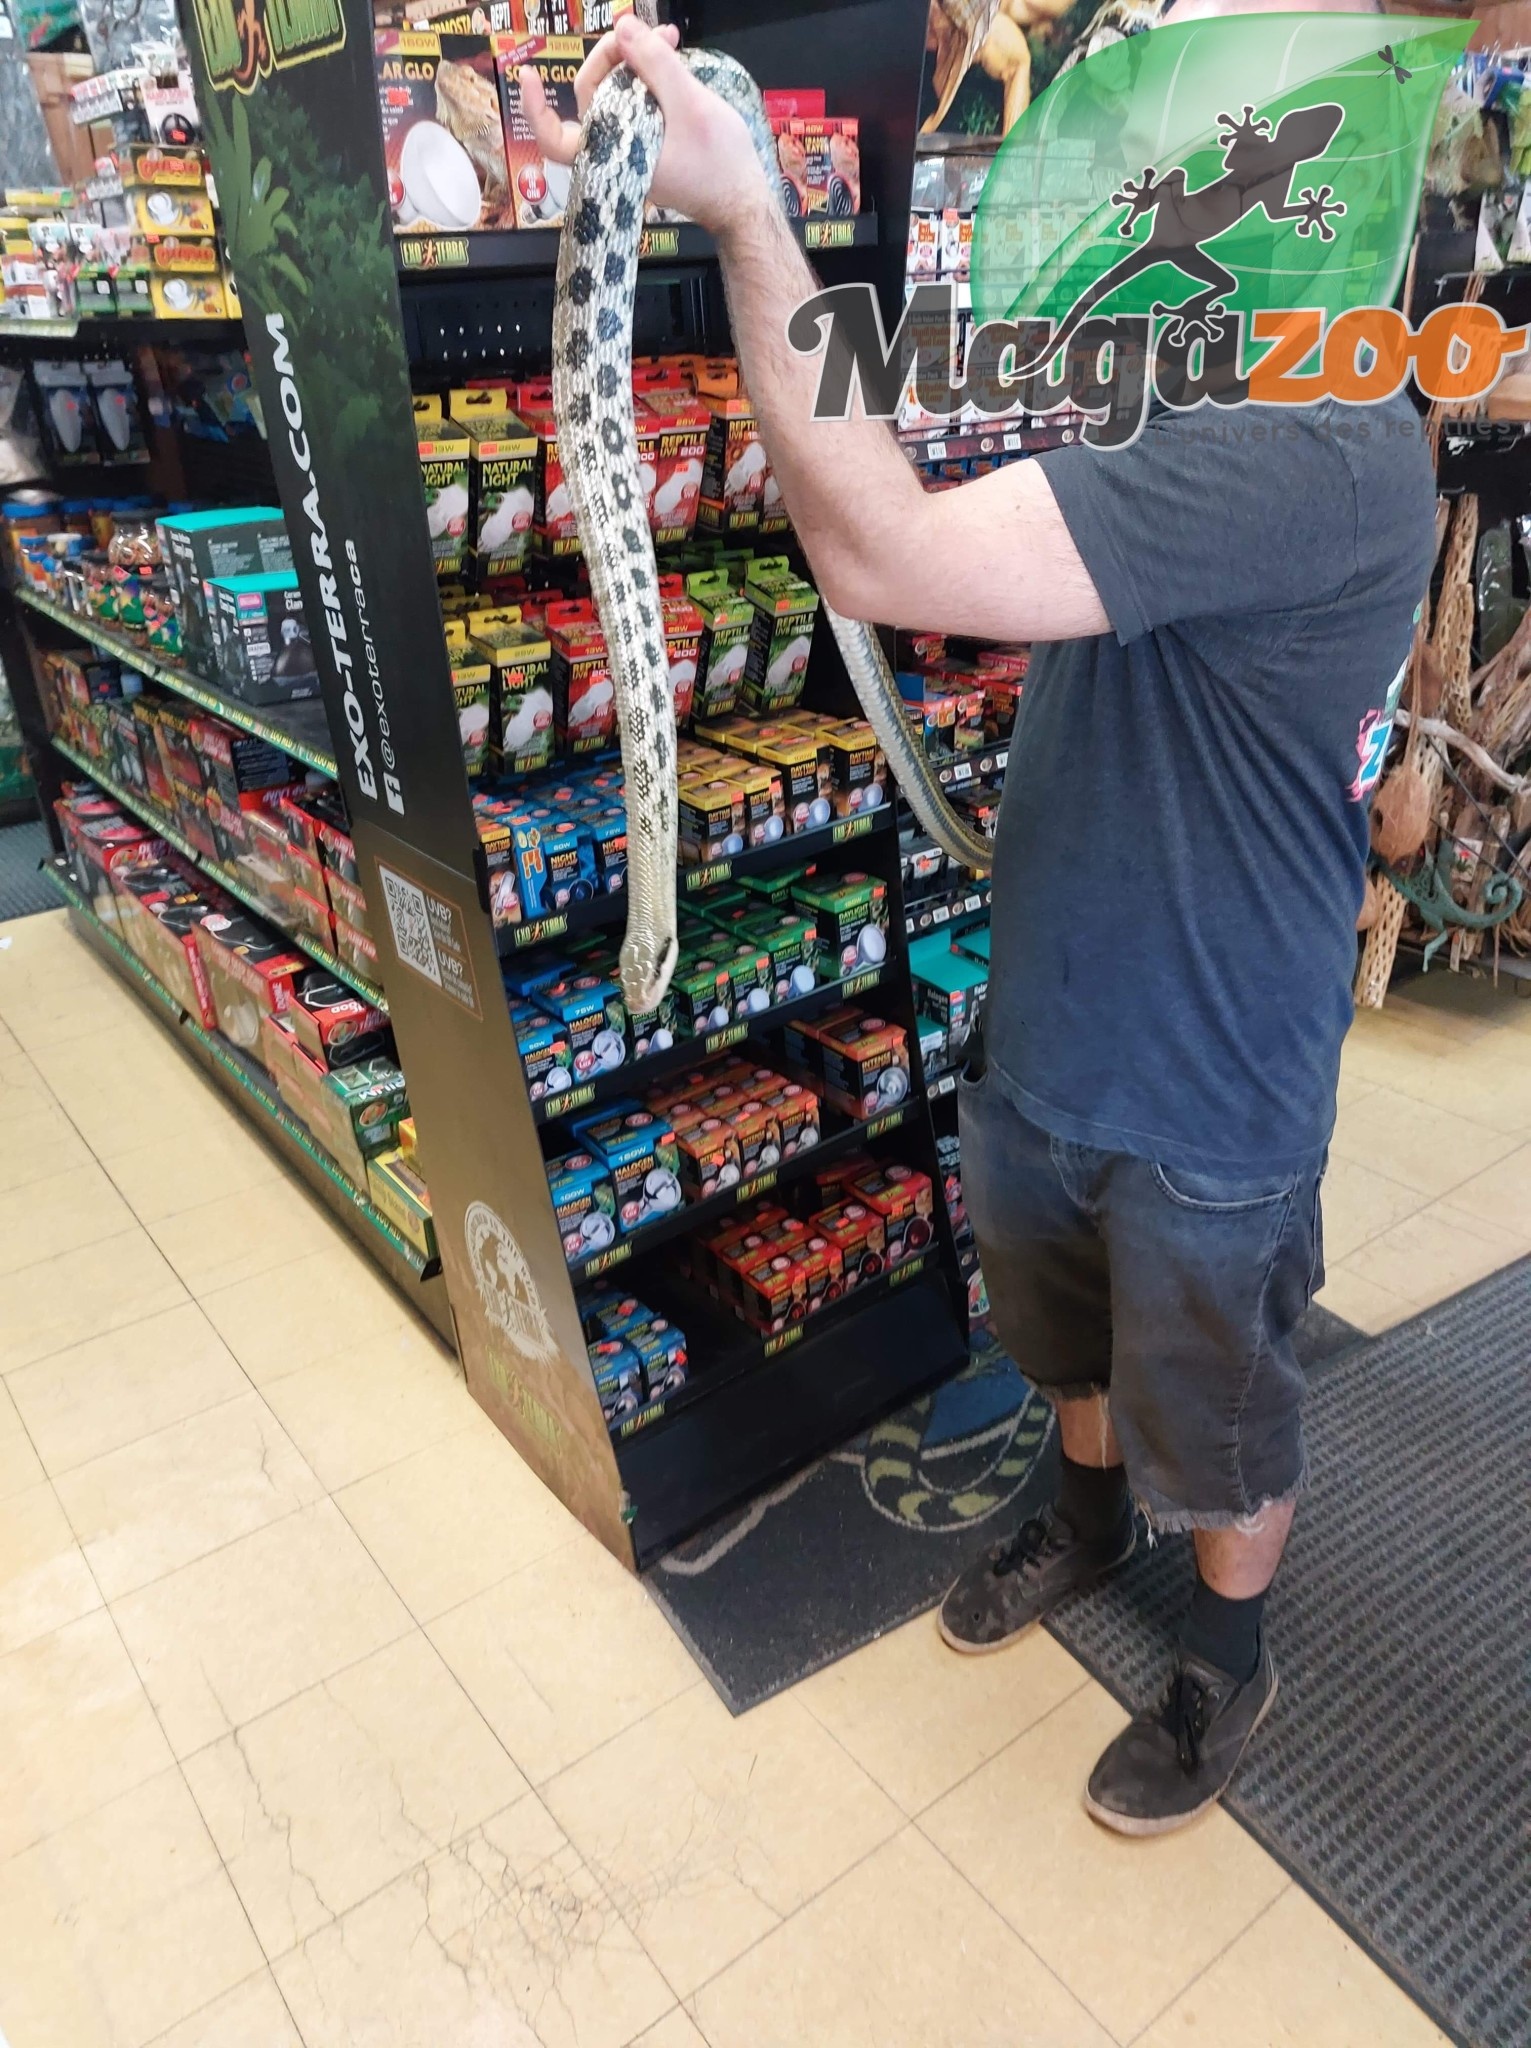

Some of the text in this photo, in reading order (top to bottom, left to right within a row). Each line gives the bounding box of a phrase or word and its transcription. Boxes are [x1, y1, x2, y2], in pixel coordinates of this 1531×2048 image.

[405, 62, 434, 80] GLO
[551, 65, 578, 82] GLO
[651, 232, 675, 252] TERRA
[807, 223, 851, 245] EXO TERRA
[403, 240, 466, 264] EXO TERRA
[729, 420, 758, 432] REPTI
[661, 433, 706, 448] REPTILE
[482, 459, 533, 474] NATURAL
[426, 474, 452, 486] IGHT
[482, 473, 519, 488] LIGHT
[266, 313, 378, 800] EXO-TERRA.COM
[777, 613, 814, 628] REPTILE
[715, 626, 749, 640] REPTILE
[345, 539, 396, 770] @exoterraca
[834, 816, 871, 840] EXO TERRA
[550, 850, 577, 864] NIGHT
[687, 863, 730, 888] EXO TERRA
[426, 895, 452, 921] UVB?
[839, 903, 869, 920] DAYLIGHT
[516, 916, 564, 944] EXO TERRA
[438, 948, 463, 977] UVB?
[843, 973, 879, 998] EXO TERRA
[569, 1012, 603, 1030] HALOGEN
[706, 1024, 748, 1050] EXO TERRA
[548, 1088, 593, 1115] EXO TERRA
[867, 1113, 901, 1139] EXO TERRA
[615, 1155, 655, 1176] HALOGEN
[737, 1172, 776, 1200] EXO TERRA
[556, 1196, 592, 1214] HALOGEN
[585, 1244, 630, 1275] EXO TERRA
[765, 1327, 802, 1356] EXO TERRA
[621, 1403, 663, 1437] EXO TERRA
